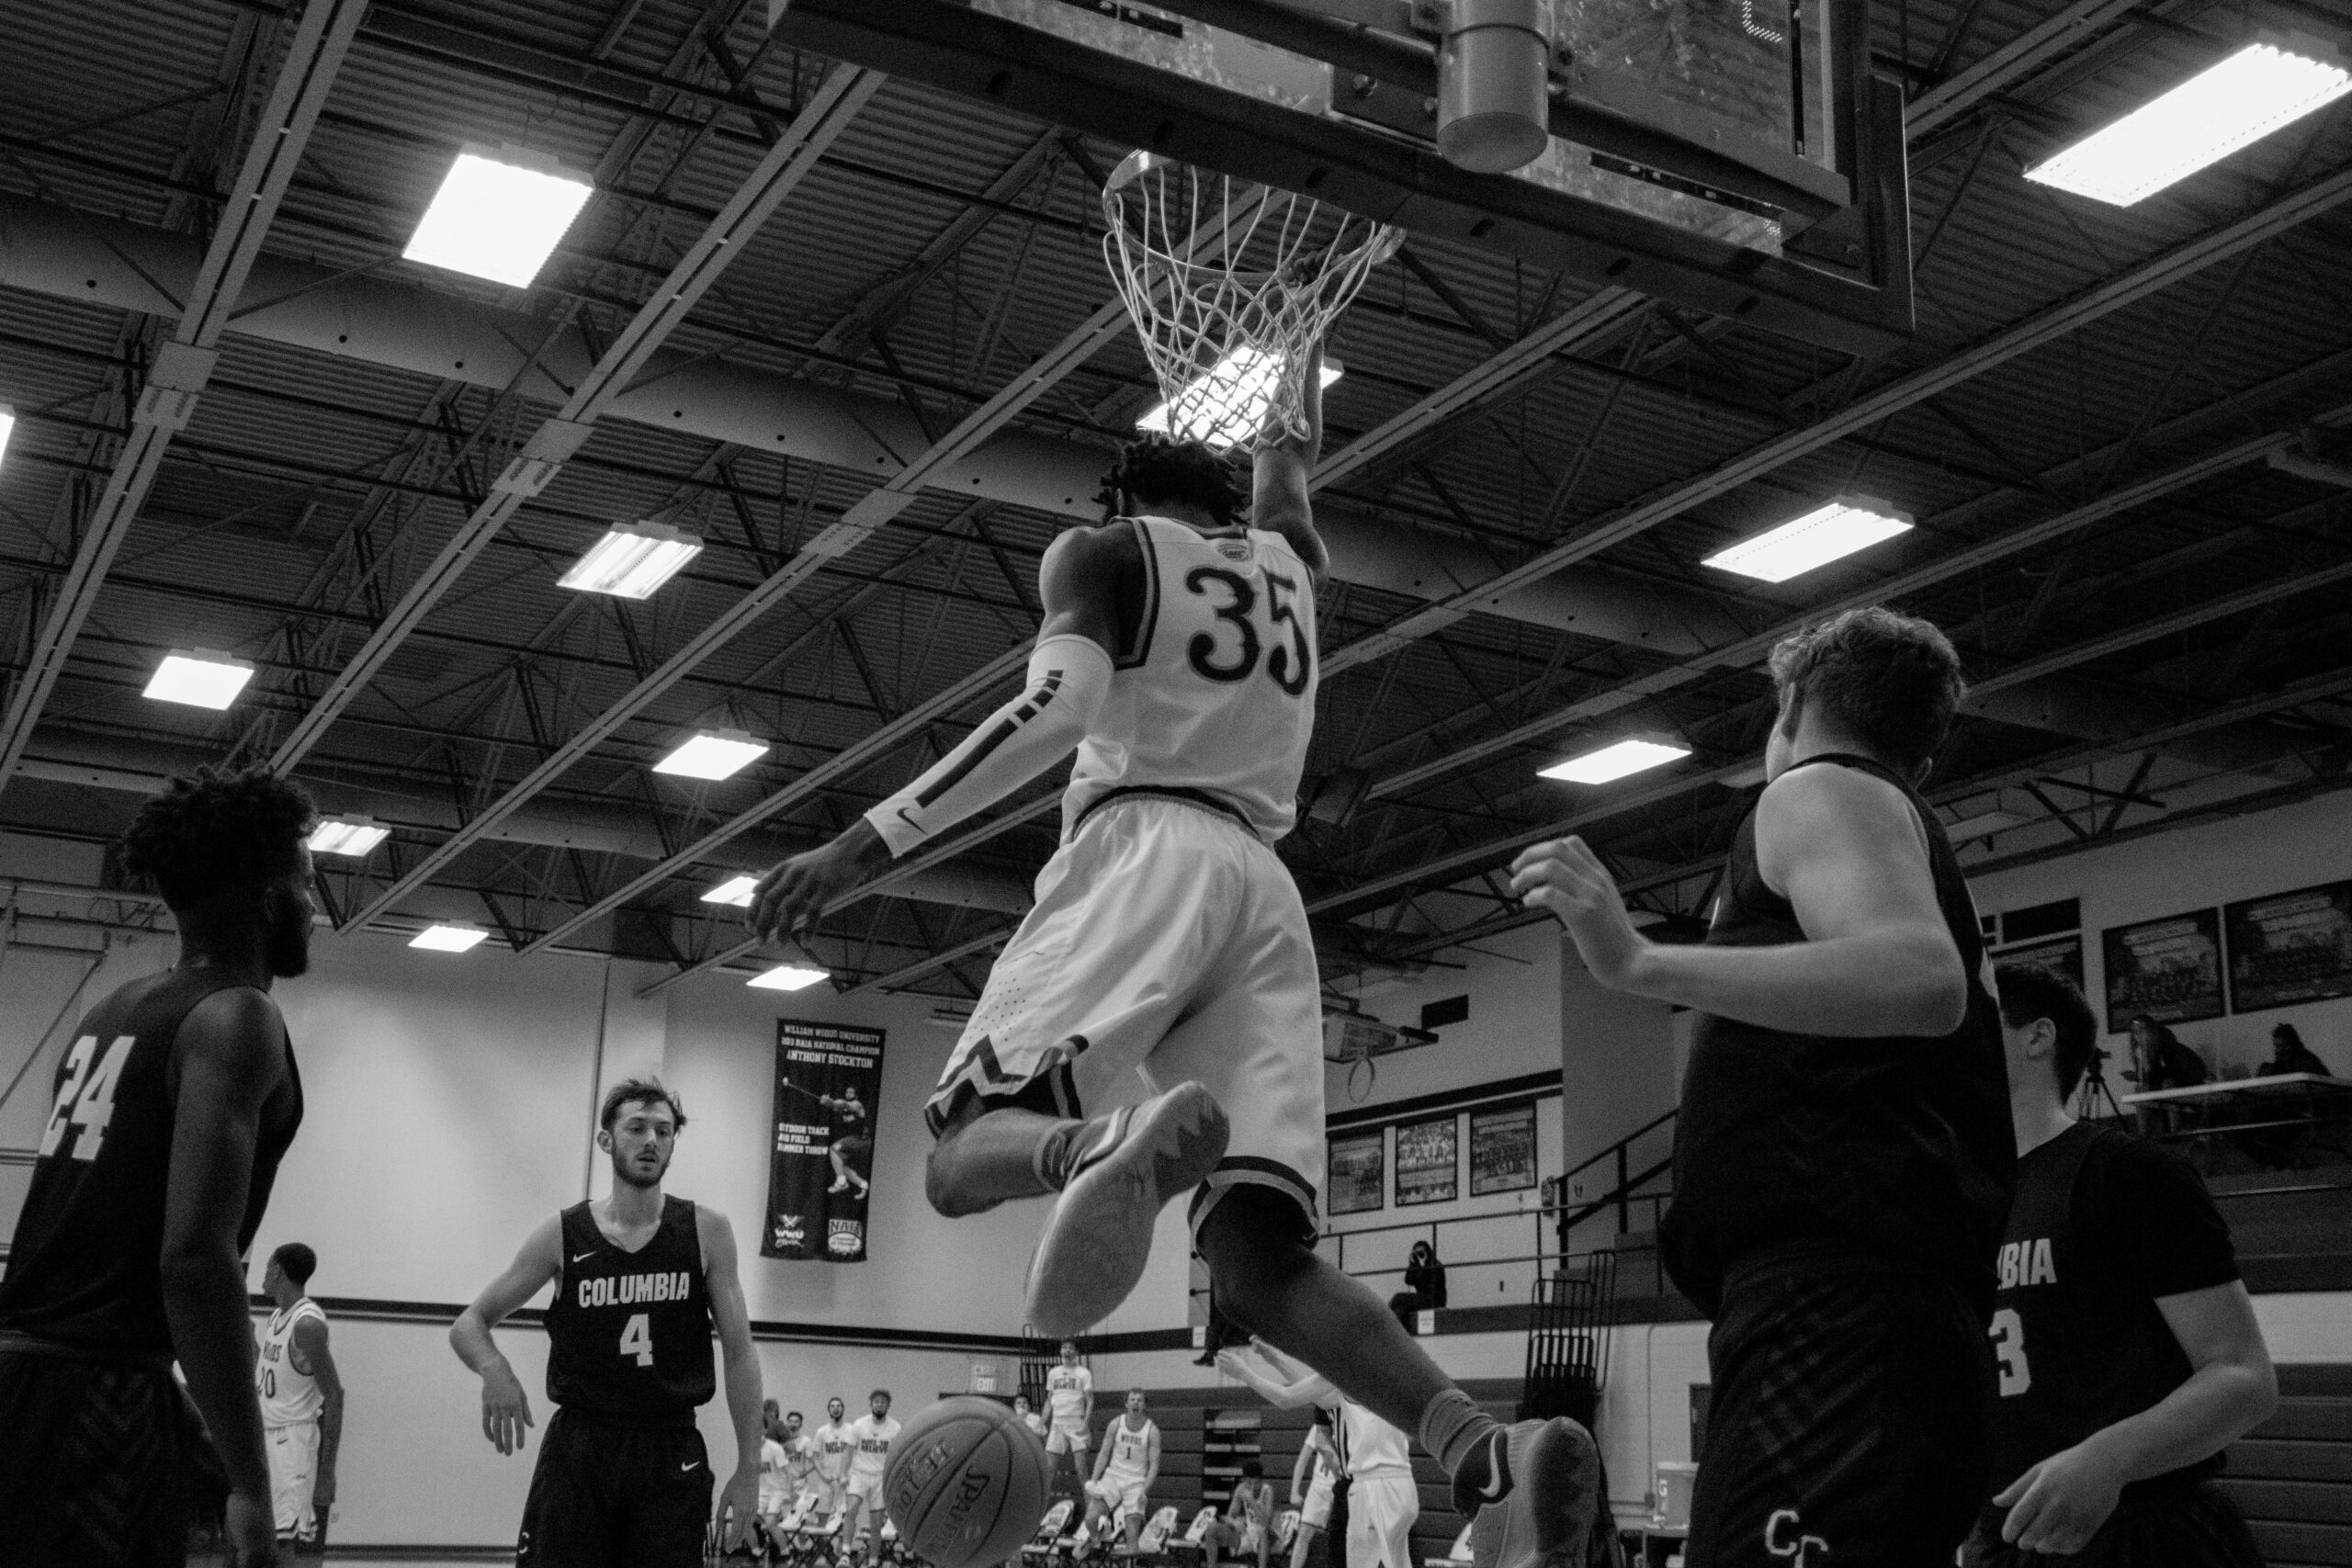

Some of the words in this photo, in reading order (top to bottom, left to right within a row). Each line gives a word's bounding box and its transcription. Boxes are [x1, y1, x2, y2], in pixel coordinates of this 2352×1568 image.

[1185, 564, 1310, 696] 35
[785, 1024, 814, 1036] WILLIAM
[814, 1028, 838, 1038] WOODS
[838, 1030, 880, 1043] UNIVERSITY
[813, 1040, 844, 1052] NATIONAL
[786, 1049, 827, 1064] ANTHONY
[827, 1053, 874, 1068] STOCKTON
[38, 1035, 136, 1162] 24
[790, 1134, 810, 1145] FIELD
[808, 1125, 831, 1136] TRACK
[830, 1220, 862, 1236] NAIA
[1996, 1237, 2058, 1291] BIA
[578, 1271, 690, 1308] COLUMBIA
[619, 1313, 654, 1368] 4
[1121, 1432, 1143, 1447] WOODS
[1126, 1446, 1134, 1461] 1
